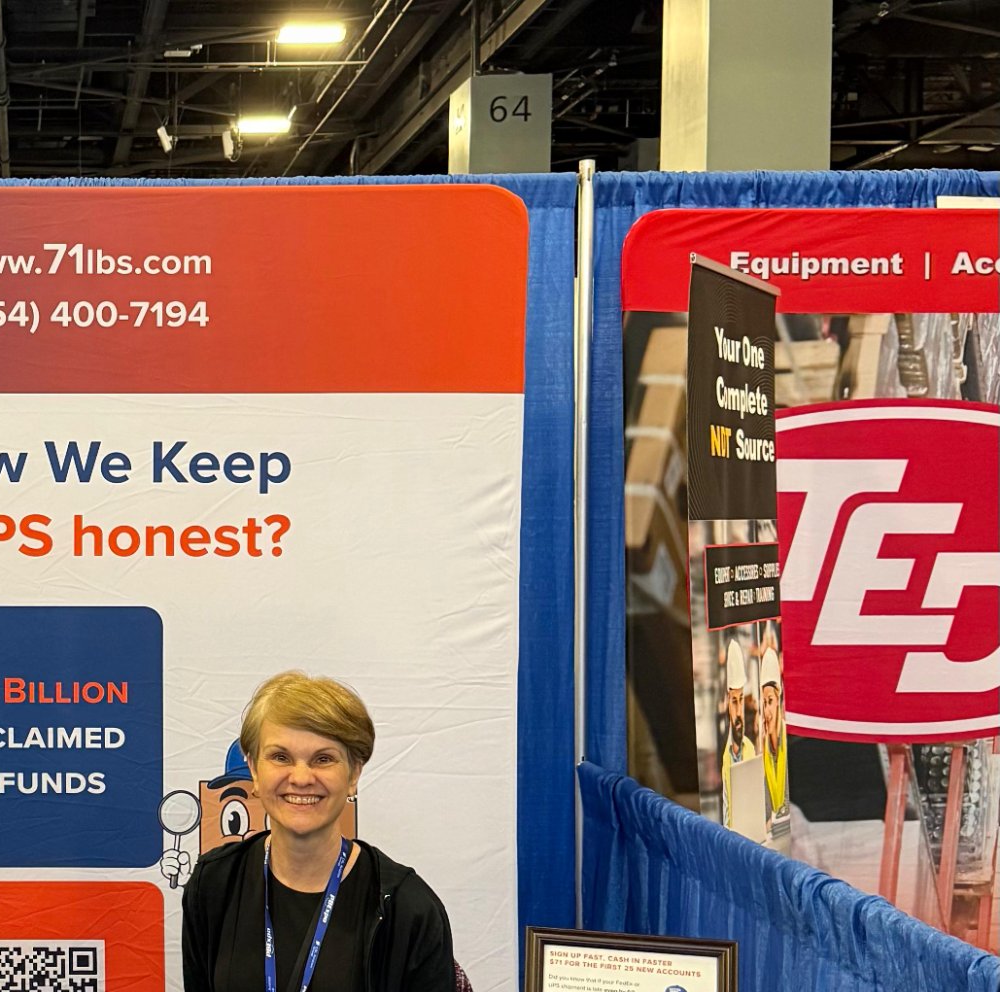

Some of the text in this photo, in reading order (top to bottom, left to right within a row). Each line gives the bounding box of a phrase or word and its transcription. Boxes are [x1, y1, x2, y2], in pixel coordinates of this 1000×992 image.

[490, 95, 532, 123] 64
[730, 251, 903, 280] Equipment
[50, 301, 209, 328] 400-7194
[714, 326, 765, 370] Your One
[716, 376, 768, 420] Complete
[735, 428, 775, 462] Source
[45, 441, 132, 483] We
[153, 441, 292, 494] Keep
[73, 513, 291, 557] honest?
[549, 950, 569, 958] SIGN
[607, 955, 629, 963] CASH
[642, 958, 673, 967] FASTER
[564, 959, 580, 967] FOR
[636, 966, 654, 974] NEW
[656, 968, 702, 978] ACCOUNTS
